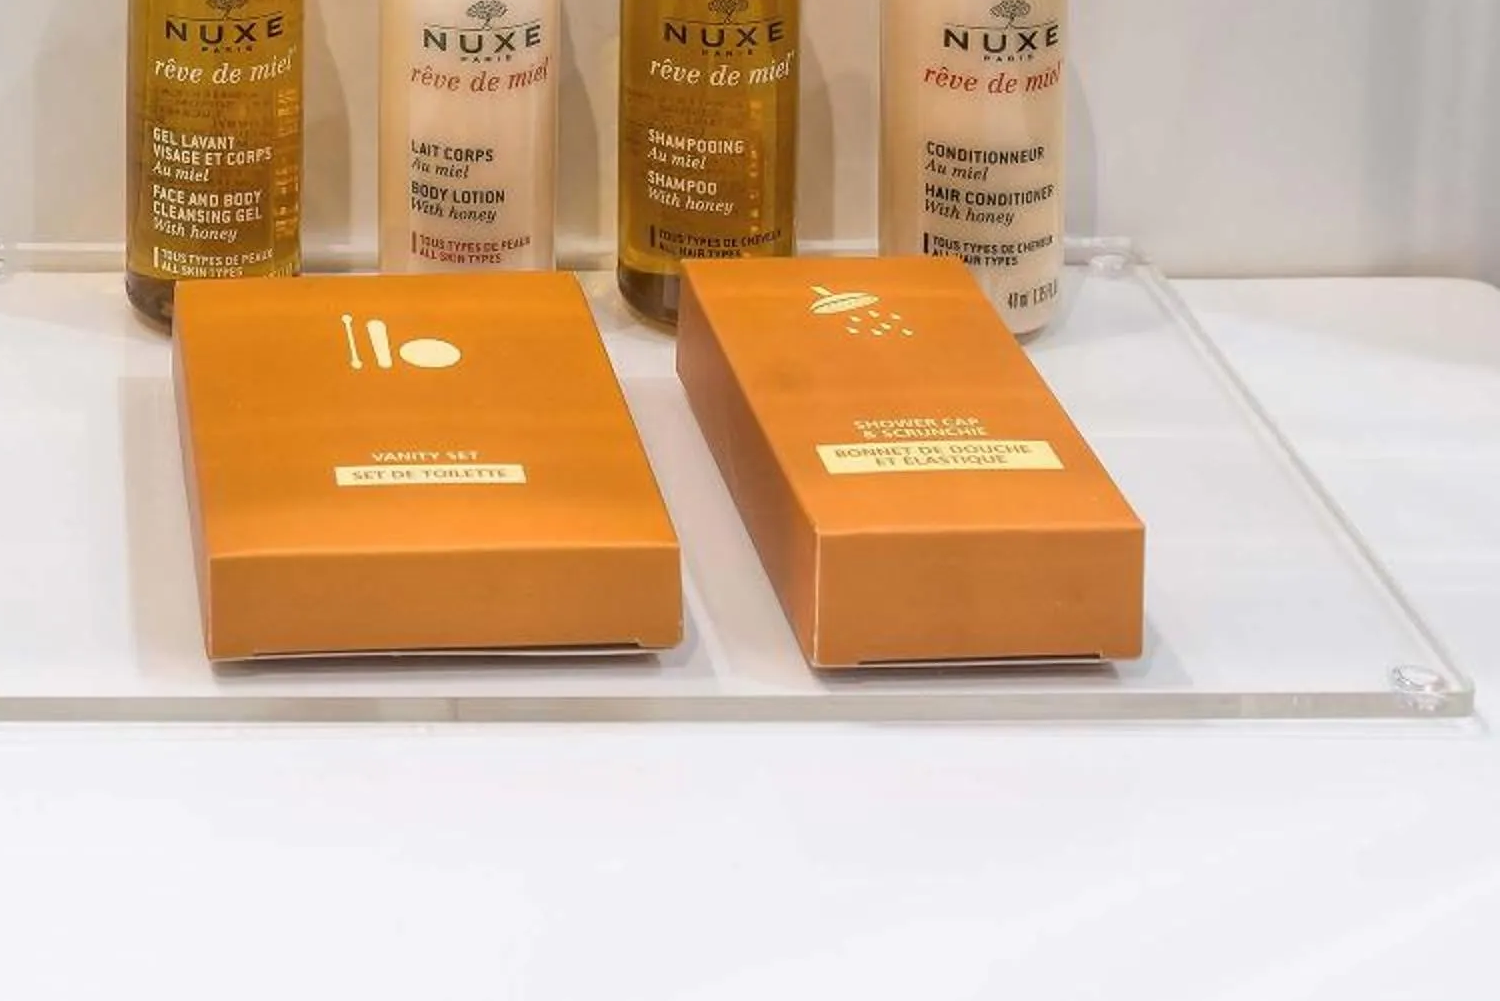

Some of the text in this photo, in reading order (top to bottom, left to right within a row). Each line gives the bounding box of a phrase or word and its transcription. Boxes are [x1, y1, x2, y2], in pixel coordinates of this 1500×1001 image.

[165, 17, 283, 44] NUXE
[423, 25, 541, 54] NUXE
[663, 20, 784, 47] NUXE
[944, 25, 1058, 53] NUXE
[154, 59, 203, 84] rêve
[212, 63, 241, 84] de
[411, 65, 461, 92] rêve
[470, 71, 500, 92] de
[650, 58, 700, 84] rêve
[710, 64, 741, 86] de
[923, 67, 978, 92] rêve
[987, 73, 1017, 94] de
[153, 127, 235, 149] GEL LAVANT
[648, 129, 745, 154] SHAMPOOING
[153, 144, 273, 166] VISAGE ET CORPS
[411, 139, 493, 162] LAIT CORPS
[648, 147, 707, 170] Au miel
[927, 141, 1045, 164] CONDITIONNEUR
[152, 161, 210, 182] Au miel
[411, 158, 469, 179] Au miel
[925, 159, 989, 182] Au miel
[411, 181, 505, 204] BODY LOTION
[648, 170, 718, 196] SHAMPOO
[925, 183, 1055, 206] HAIR CONDITIONER
[153, 185, 262, 208] FACE AND BODY
[649, 186, 734, 216] With honey
[153, 201, 262, 224] CLEANSING GEL
[411, 197, 497, 223] With honey
[925, 199, 1015, 227] With honey
[153, 217, 237, 243] With honey
[963, 242, 997, 254] TYPES
[1001, 244, 1015, 254] DE
[225, 255, 239, 266] DE
[854, 417, 979, 429] SHOWER CAP
[883, 427, 988, 438] SCRUNCHIE
[371, 450, 479, 462] VANITY SET
[834, 444, 1032, 458] BONNET DE DOUCHE
[876, 457, 897, 466] ET
[352, 468, 507, 480] SET DE TOILETTE
